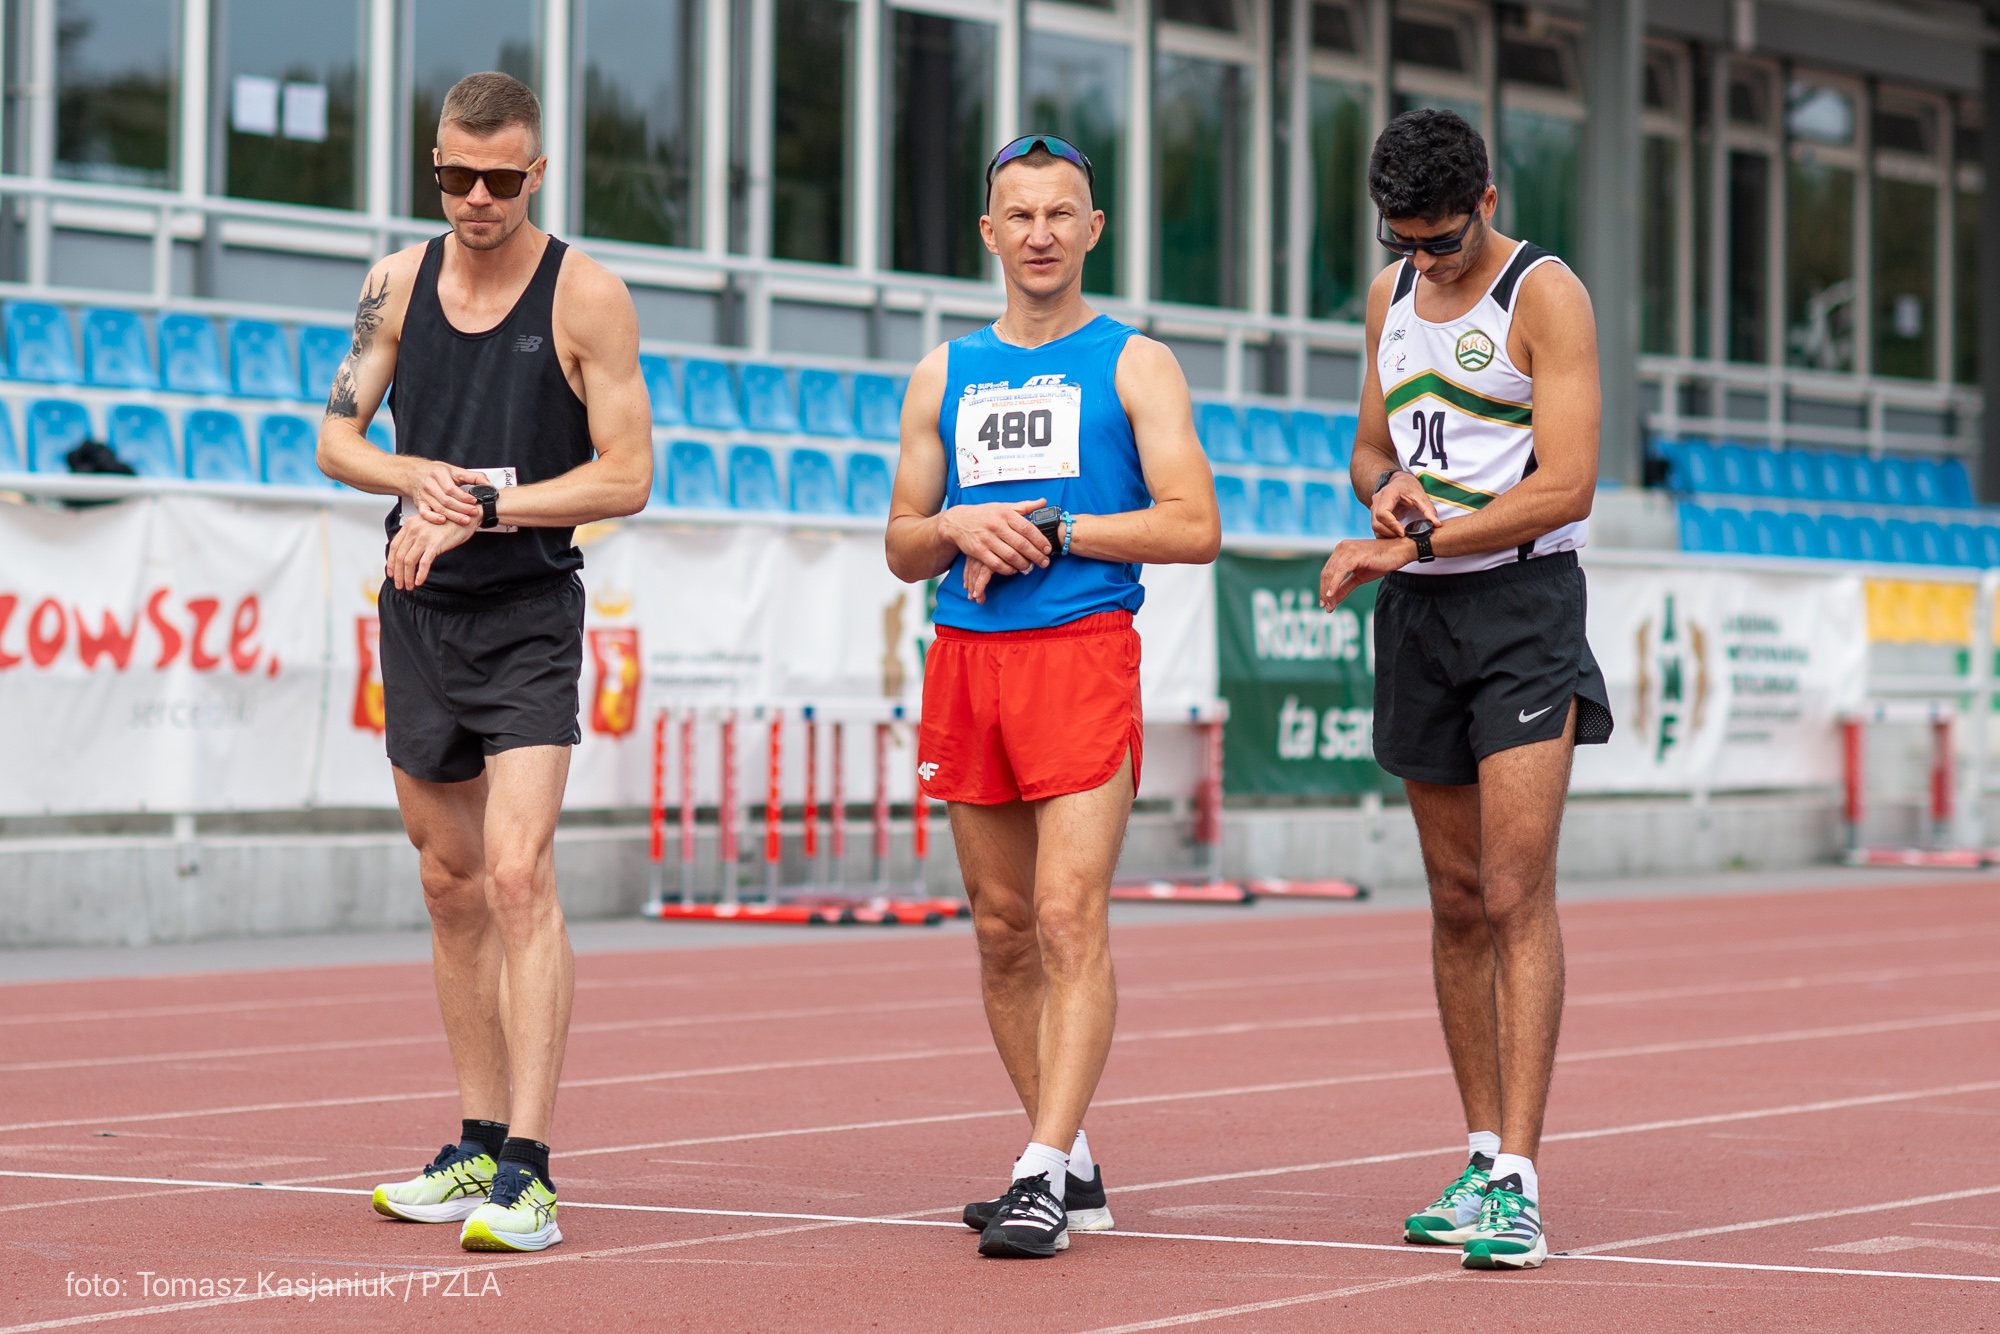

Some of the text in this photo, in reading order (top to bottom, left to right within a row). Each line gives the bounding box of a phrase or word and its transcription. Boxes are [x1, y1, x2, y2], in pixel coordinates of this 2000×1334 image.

[1461, 336, 1489, 352] RKS
[978, 408, 1053, 451] 480
[1409, 410, 1448, 470] 24
[1252, 587, 1360, 661] Różne
[1278, 694, 1316, 759] ta
[917, 761, 940, 781] 4F
